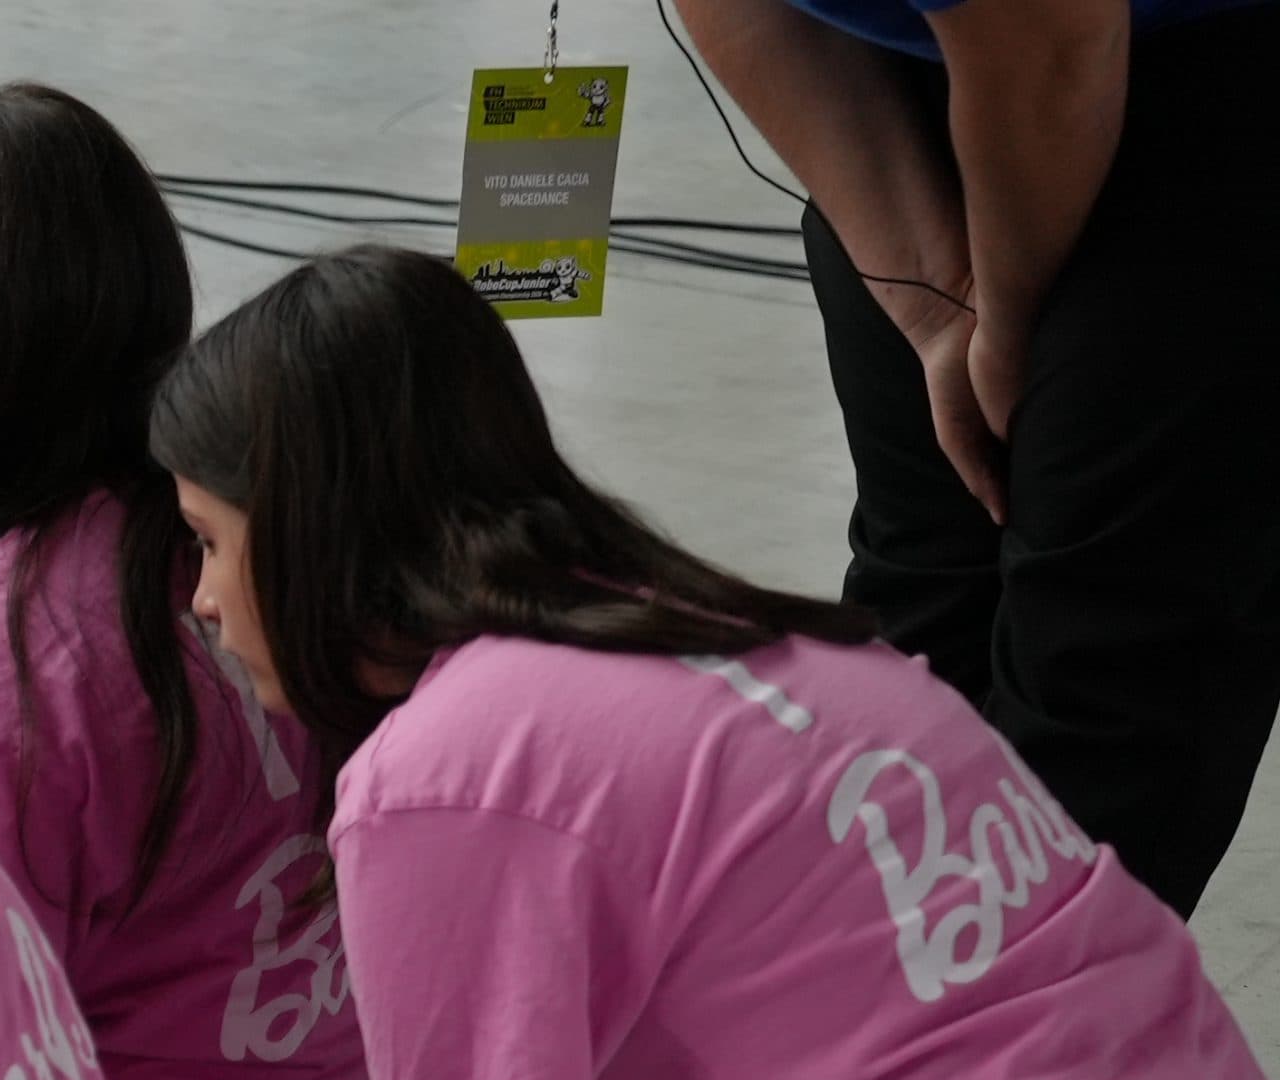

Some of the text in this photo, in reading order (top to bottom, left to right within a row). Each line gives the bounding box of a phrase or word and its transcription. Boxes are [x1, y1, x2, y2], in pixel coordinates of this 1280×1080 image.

[484, 172, 589, 190] VITO DANIELE CACIA
[499, 191, 569, 207] SPACEDANCE
